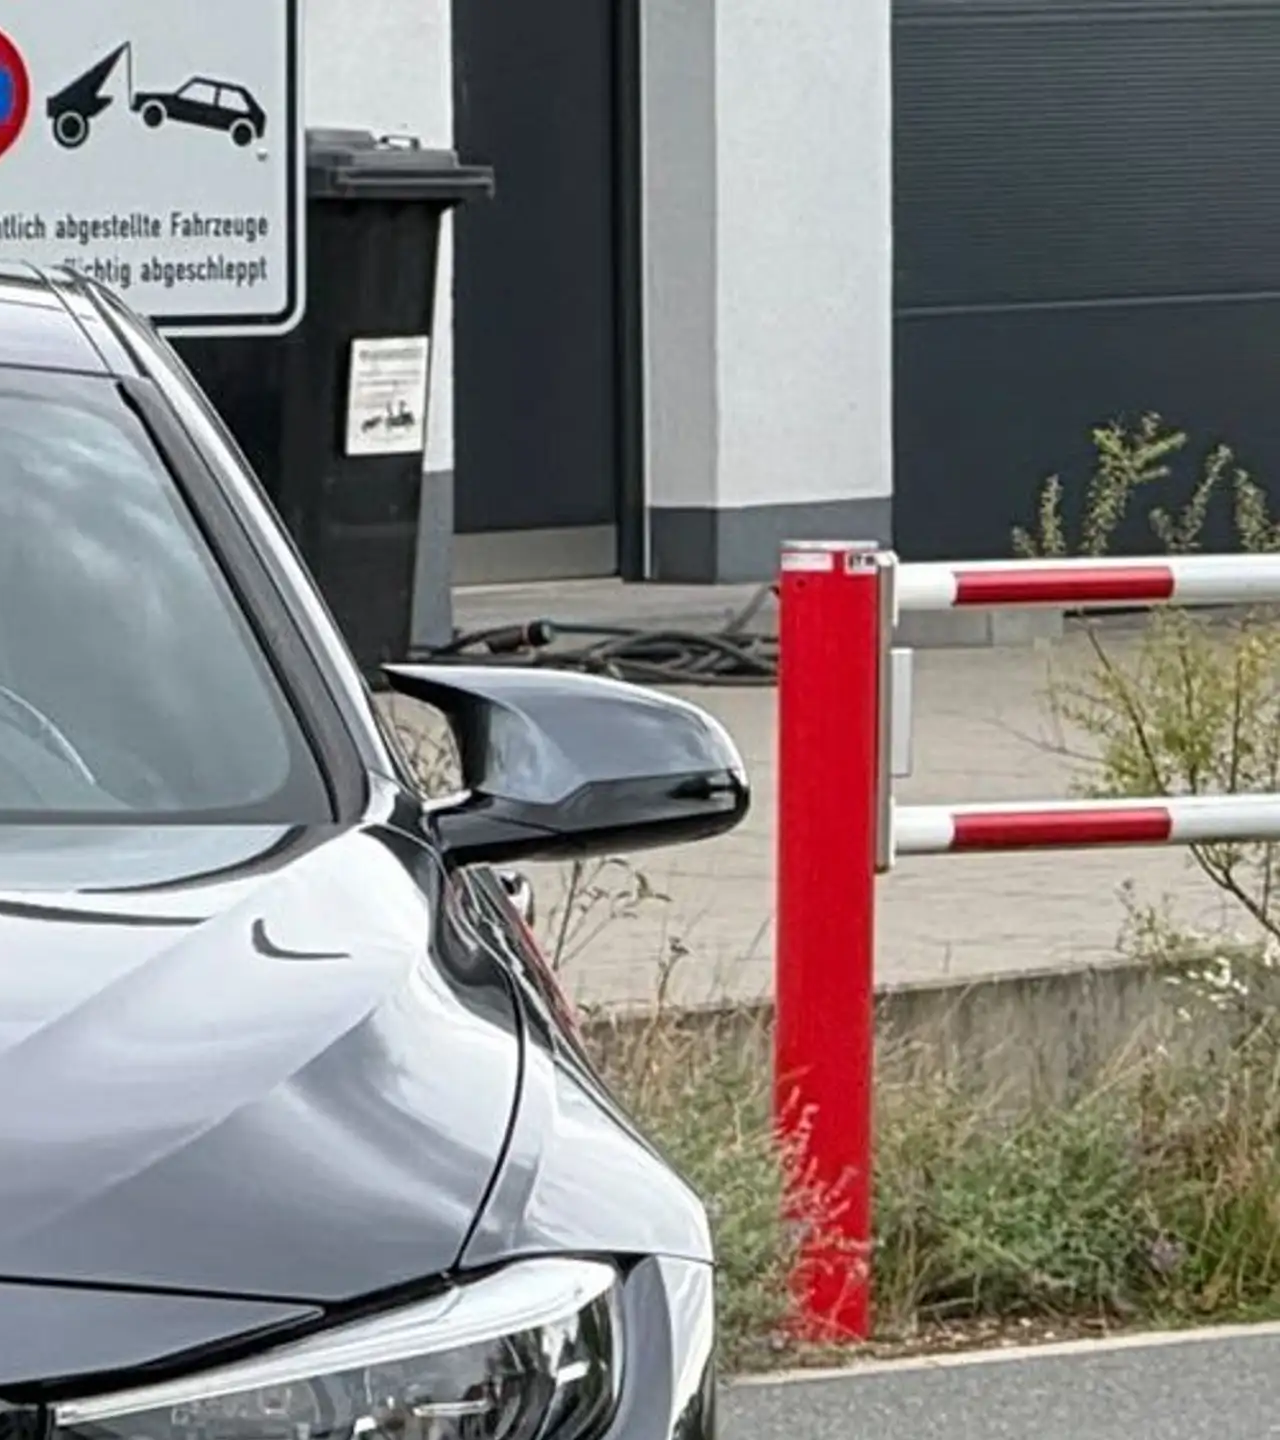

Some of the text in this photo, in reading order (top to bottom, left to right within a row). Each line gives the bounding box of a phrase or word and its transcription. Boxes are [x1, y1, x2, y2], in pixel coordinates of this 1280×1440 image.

[55, 213, 161, 245] abgestellte
[170, 211, 268, 243] Fahrzeuge
[140, 254, 267, 288] abgeschleppt
